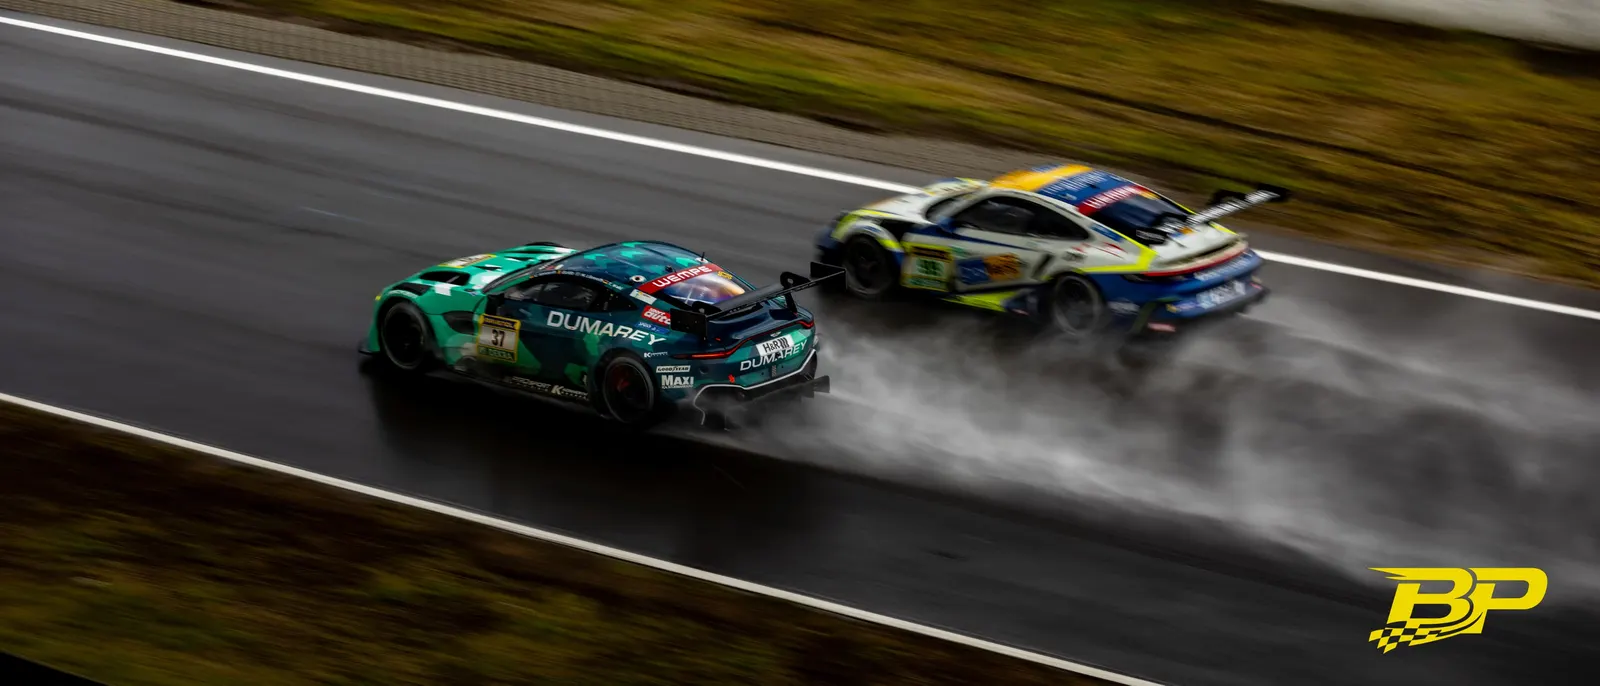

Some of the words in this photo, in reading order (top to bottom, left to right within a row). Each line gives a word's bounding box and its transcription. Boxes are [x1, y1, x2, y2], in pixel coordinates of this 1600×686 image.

[652, 266, 713, 288] WEMPE
[491, 328, 505, 348] 37
[546, 310, 667, 346] DUMAREY
[740, 338, 808, 371] DUMAREY
